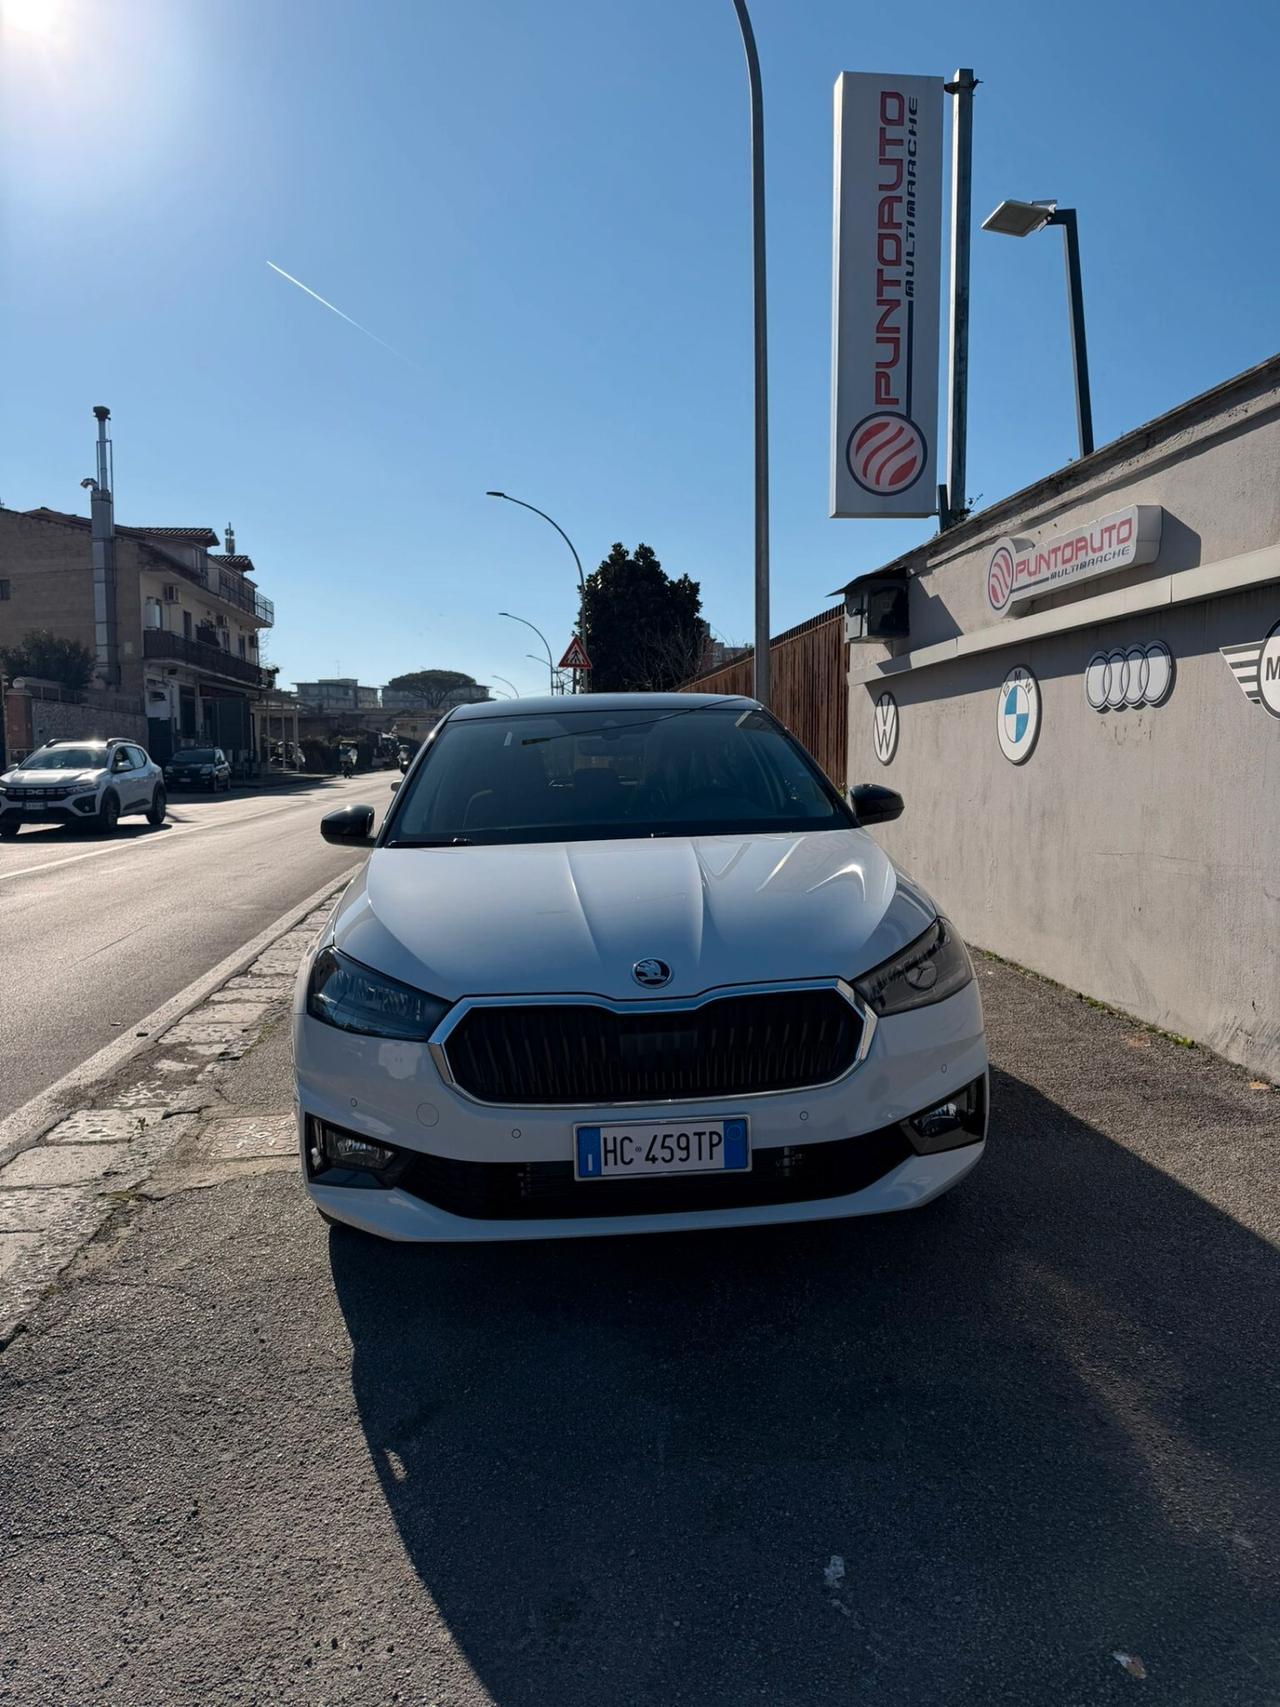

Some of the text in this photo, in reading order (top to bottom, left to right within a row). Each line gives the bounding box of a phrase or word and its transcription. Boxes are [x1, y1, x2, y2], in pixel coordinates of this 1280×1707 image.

[905, 96, 918, 298] MULTIMARCHE
[874, 90, 906, 405] PUNTOAUTO
[1015, 518, 1133, 582] PUNTOAUTO
[1049, 545, 1131, 579] MULTIMARCHE
[1003, 669, 1033, 697] BMW
